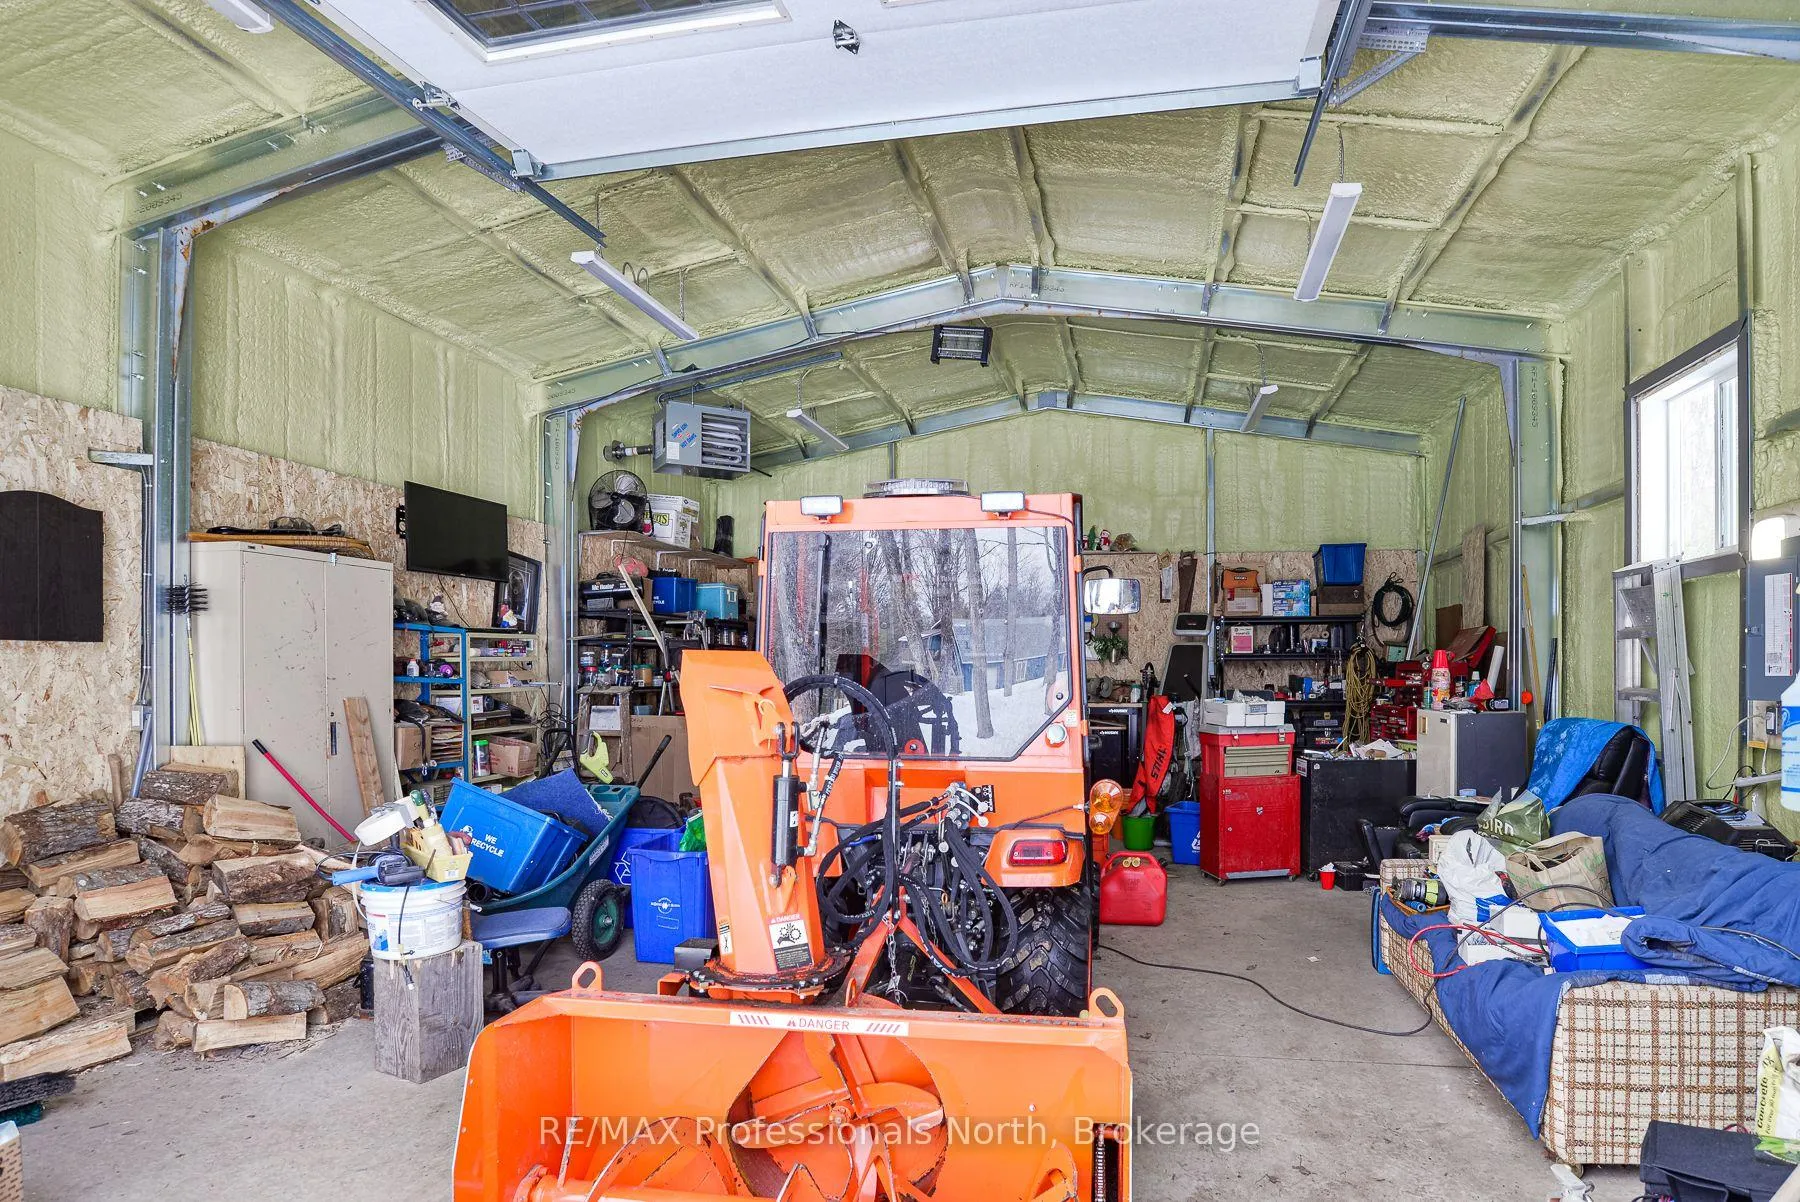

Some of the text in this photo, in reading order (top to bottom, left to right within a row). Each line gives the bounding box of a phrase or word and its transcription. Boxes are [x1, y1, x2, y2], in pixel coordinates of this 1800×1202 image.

[1151, 746, 1167, 779] STIHL
[485, 833, 498, 845] WE
[471, 837, 505, 858] RECYCLE
[776, 914, 801, 923] DANGER
[799, 1018, 850, 1031] DANGER
